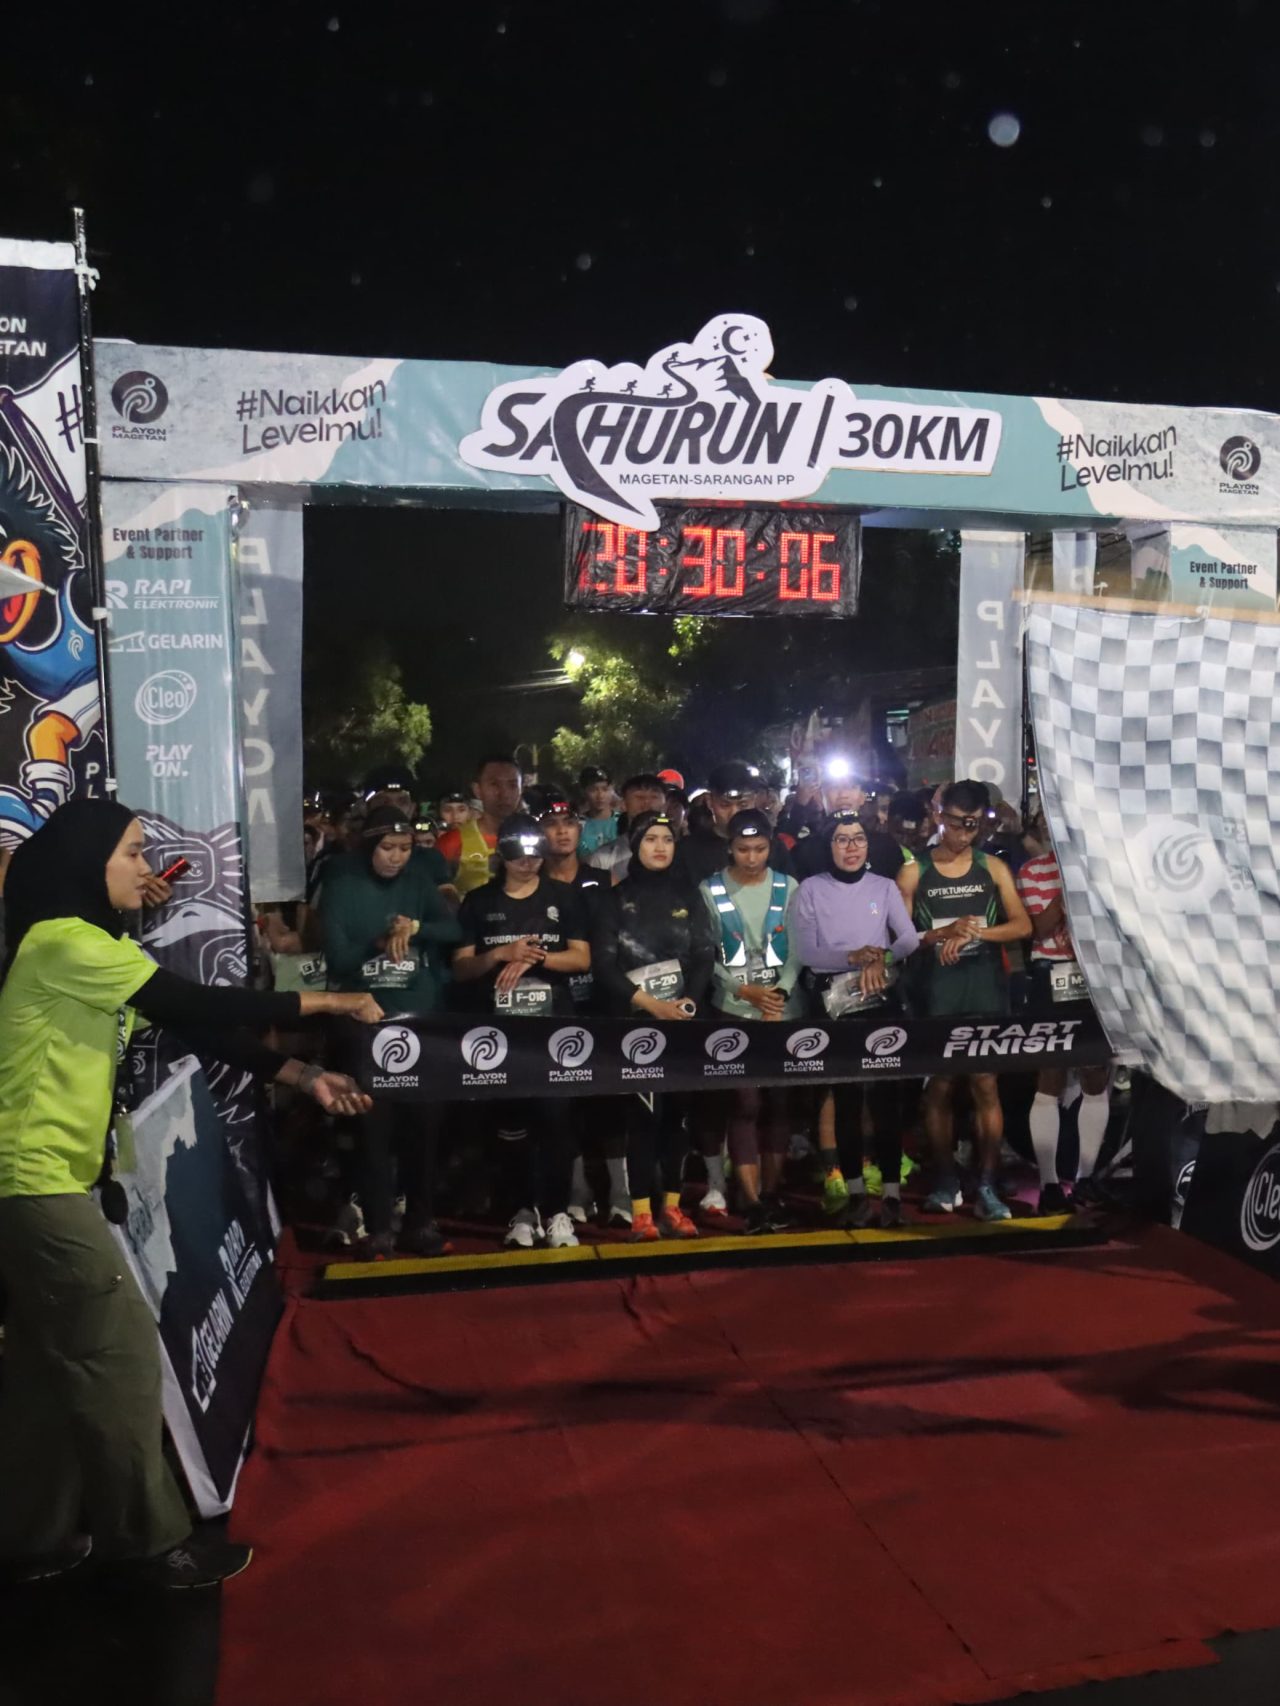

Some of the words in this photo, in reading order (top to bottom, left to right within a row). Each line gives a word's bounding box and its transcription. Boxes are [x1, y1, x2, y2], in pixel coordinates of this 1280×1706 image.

[236, 379, 387, 422] #Naikkan
[111, 425, 167, 436] PLAYON
[242, 408, 383, 454] Levelmu!
[111, 433, 167, 442] MAGETAN
[839, 411, 991, 463] 30KM
[1057, 425, 1177, 463] #Naikkan
[1061, 452, 1174, 492] Levelmu!
[619, 473, 773, 486] MAGETAN-SARANGAN
[776, 474, 795, 486] PP
[1219, 482, 1259, 490] PLAYON
[113, 527, 150, 542] Event
[154, 528, 204, 543] Partner
[126, 545, 135, 560] &
[139, 545, 193, 561] Support
[1190, 561, 1218, 574] Event
[1220, 562, 1258, 575] Partner
[134, 579, 192, 595] RAPI
[1209, 577, 1249, 590] Support
[133, 599, 219, 610] ELEKTRONIK
[148, 633, 223, 649] GELARIN
[147, 684, 185, 709] Cleo
[146, 744, 193, 761] PLAY
[949, 1020, 1082, 1041] START
[943, 1033, 1074, 1058] FINISH
[784, 1059, 824, 1069] PLAYON
[862, 1056, 901, 1066] PLAYON
[862, 1061, 901, 1069] MAGETAN
[549, 1069, 592, 1078] PLAYON
[622, 1066, 663, 1075] PLAYON
[704, 1063, 745, 1073] PLAYON
[704, 1068, 745, 1076] MAGETAN
[373, 1075, 418, 1083] PLAYON
[462, 1072, 507, 1081] PLAYON
[549, 1075, 592, 1083] MAGETAN
[622, 1071, 664, 1079] MAGETAN
[462, 1078, 507, 1086] MAGETAN
